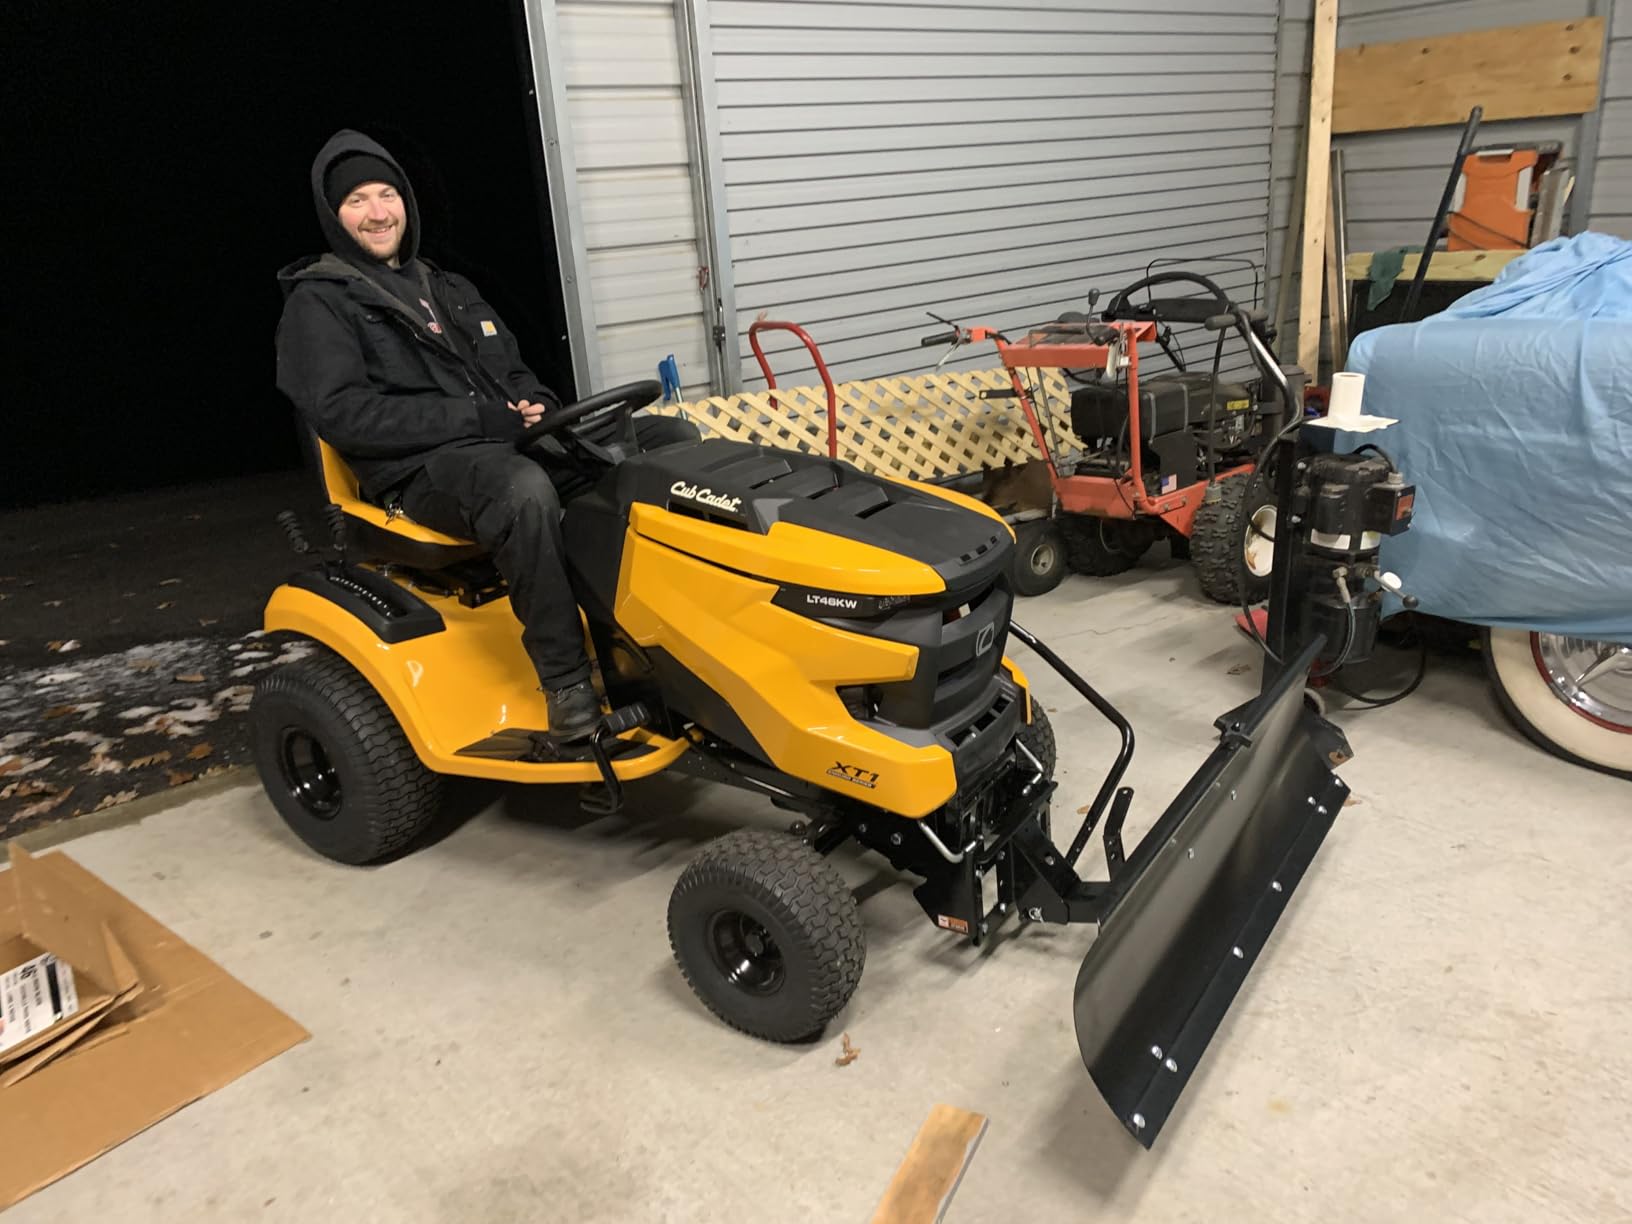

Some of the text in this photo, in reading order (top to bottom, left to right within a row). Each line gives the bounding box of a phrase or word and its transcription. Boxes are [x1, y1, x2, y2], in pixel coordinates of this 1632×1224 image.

[670, 481, 742, 512] Cub Cadet
[831, 761, 880, 783] XT1
